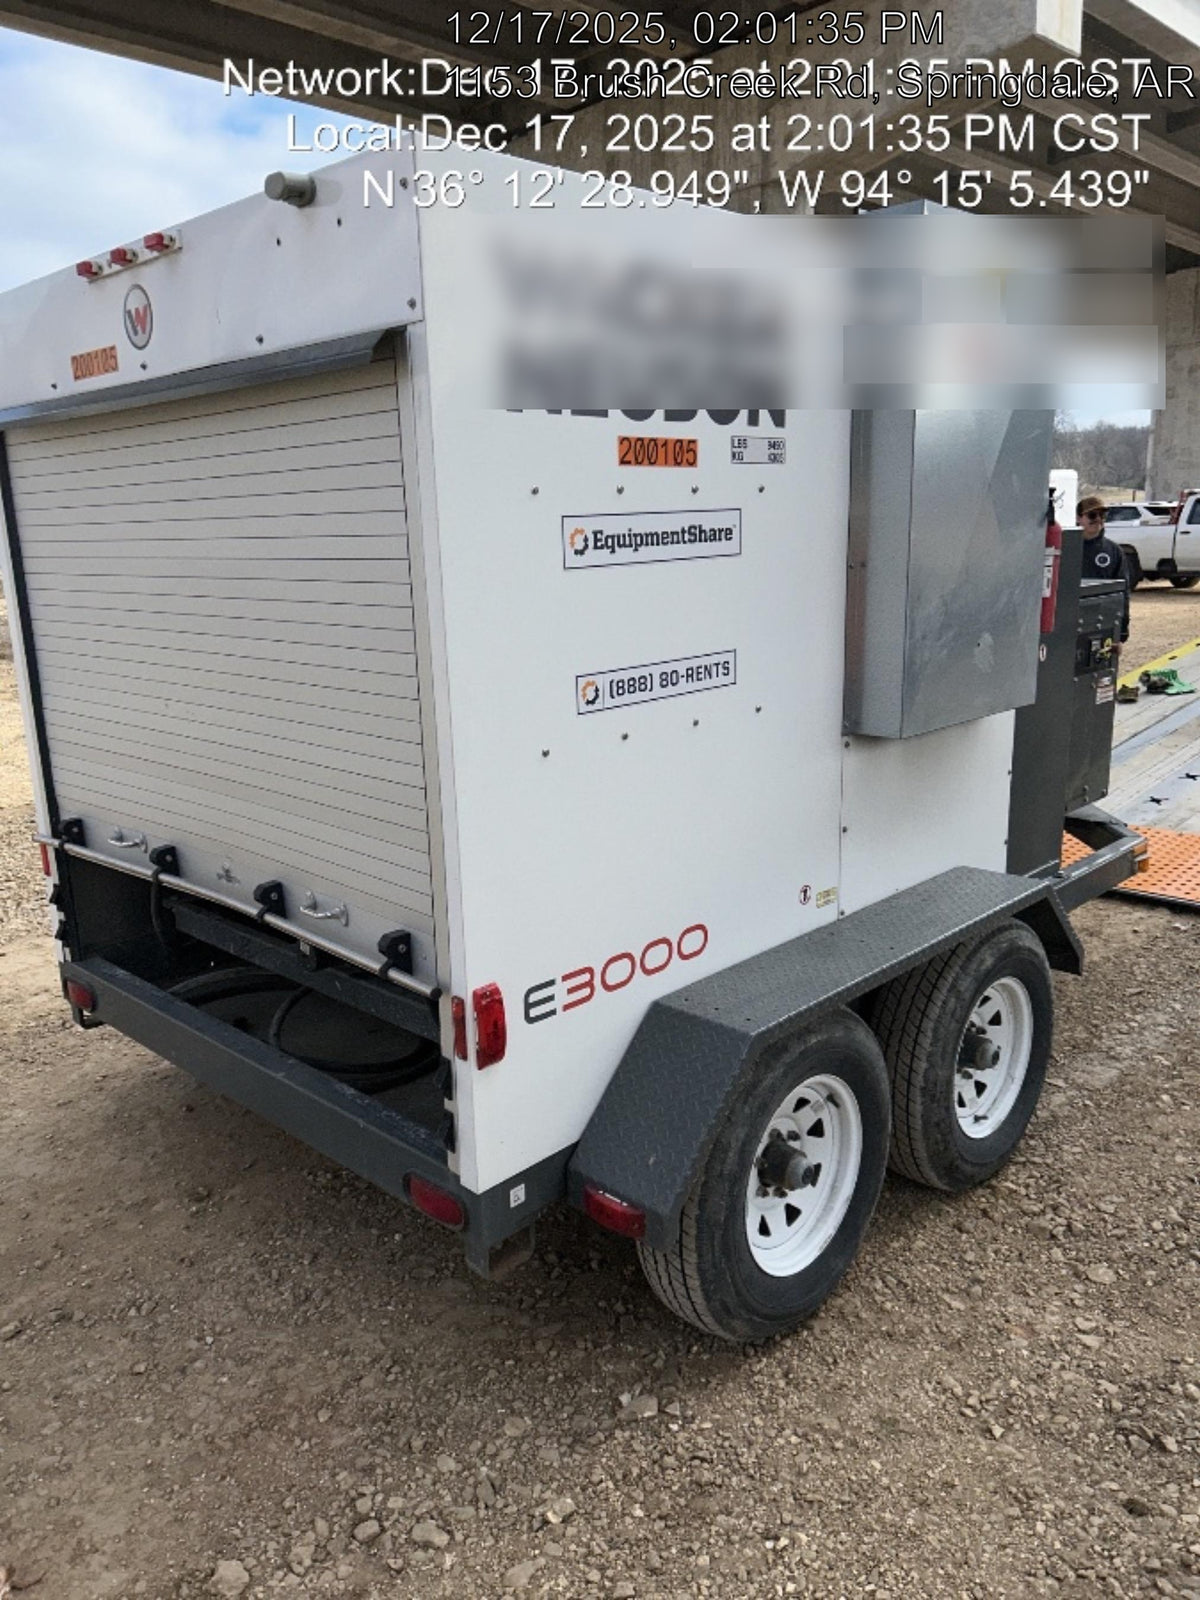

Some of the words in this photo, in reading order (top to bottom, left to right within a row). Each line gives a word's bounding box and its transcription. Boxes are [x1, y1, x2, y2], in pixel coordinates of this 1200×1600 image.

[72, 347, 118, 379] 200105
[618, 437, 698, 466] 200105
[591, 525, 734, 553] EquipmentShare
[609, 673, 653, 699] (888)
[658, 660, 731, 689] 80-RENTS
[523, 923, 710, 1025] E3000
